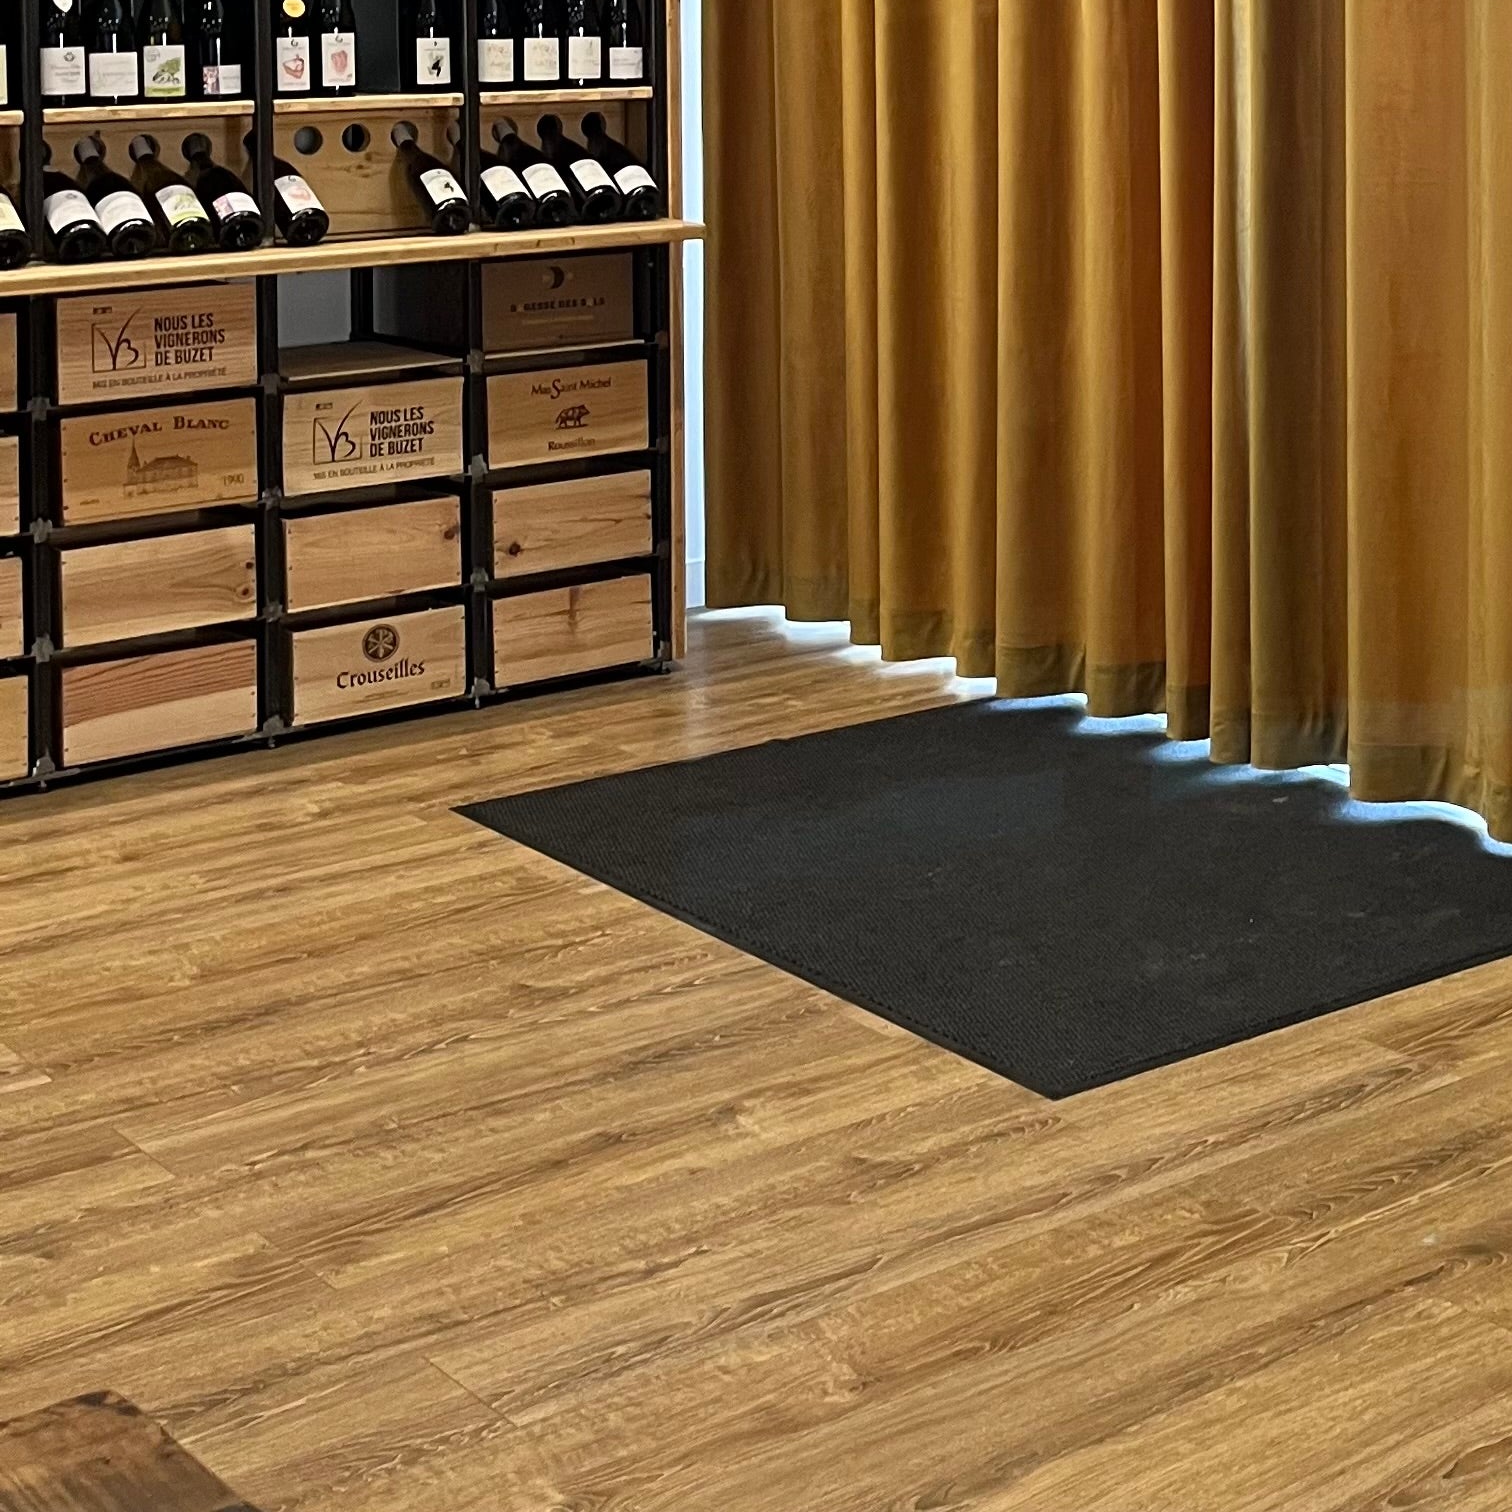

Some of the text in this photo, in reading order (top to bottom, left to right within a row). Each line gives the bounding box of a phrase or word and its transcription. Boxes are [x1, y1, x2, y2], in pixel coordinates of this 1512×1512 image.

[154, 312, 214, 333] NOUS LES
[154, 328, 226, 349] VIGNERONS
[154, 346, 214, 367] DE BUZET
[369, 406, 424, 426] NOUS LES
[89, 416, 230, 446] CHEVAL BLANC
[369, 420, 435, 442] VIGNERONS
[369, 437, 424, 458] DE BUZET
[336, 657, 425, 689] Crouseilles
